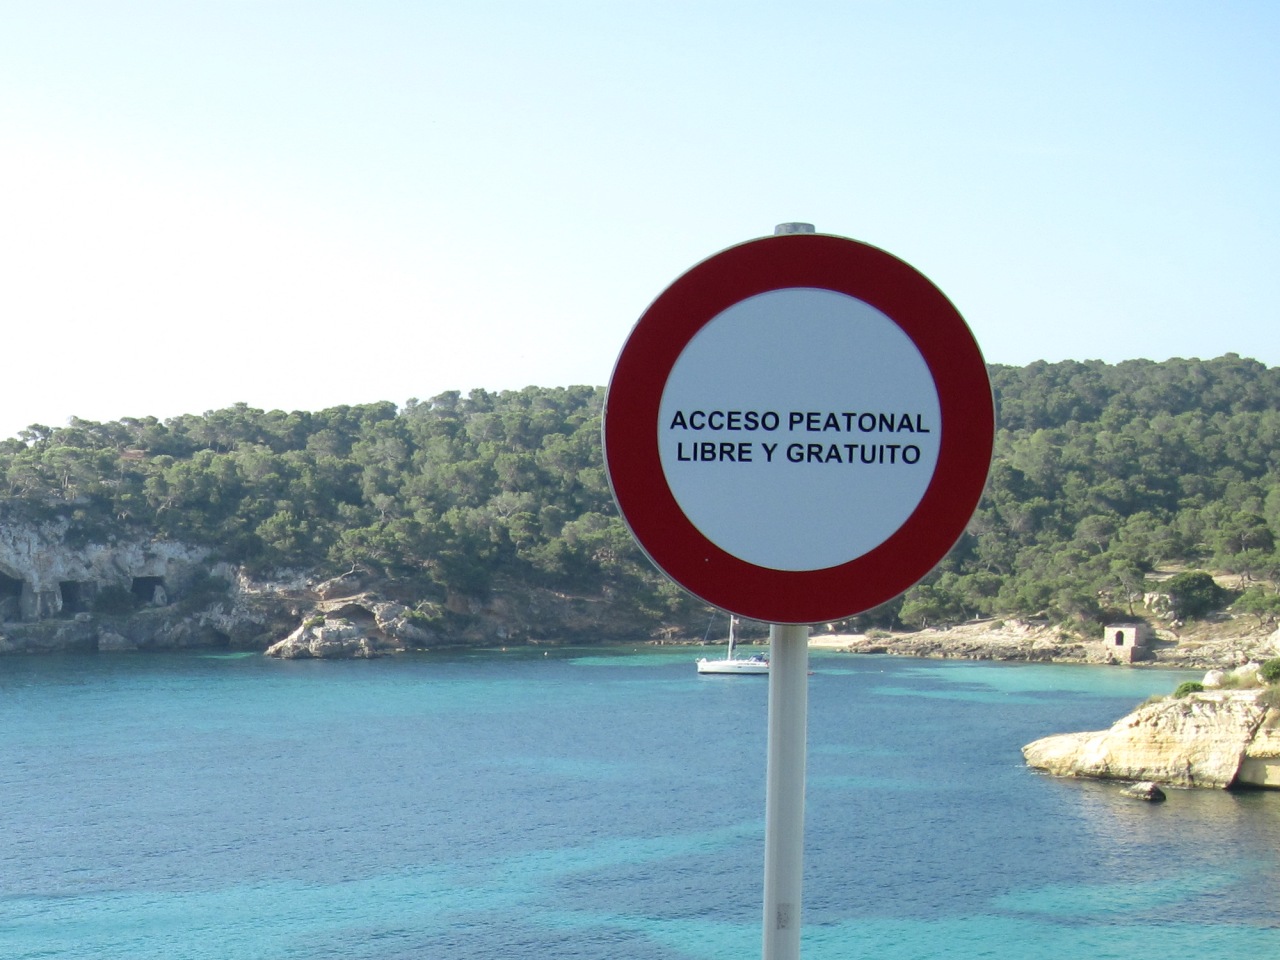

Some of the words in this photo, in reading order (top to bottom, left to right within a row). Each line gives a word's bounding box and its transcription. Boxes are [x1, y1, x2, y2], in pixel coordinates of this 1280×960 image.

[670, 411, 779, 431] ACCESO
[789, 412, 930, 433] PEATONAL
[677, 442, 752, 463] LIBRE
[762, 443, 778, 463] Y
[786, 443, 921, 465] GRATUITO
